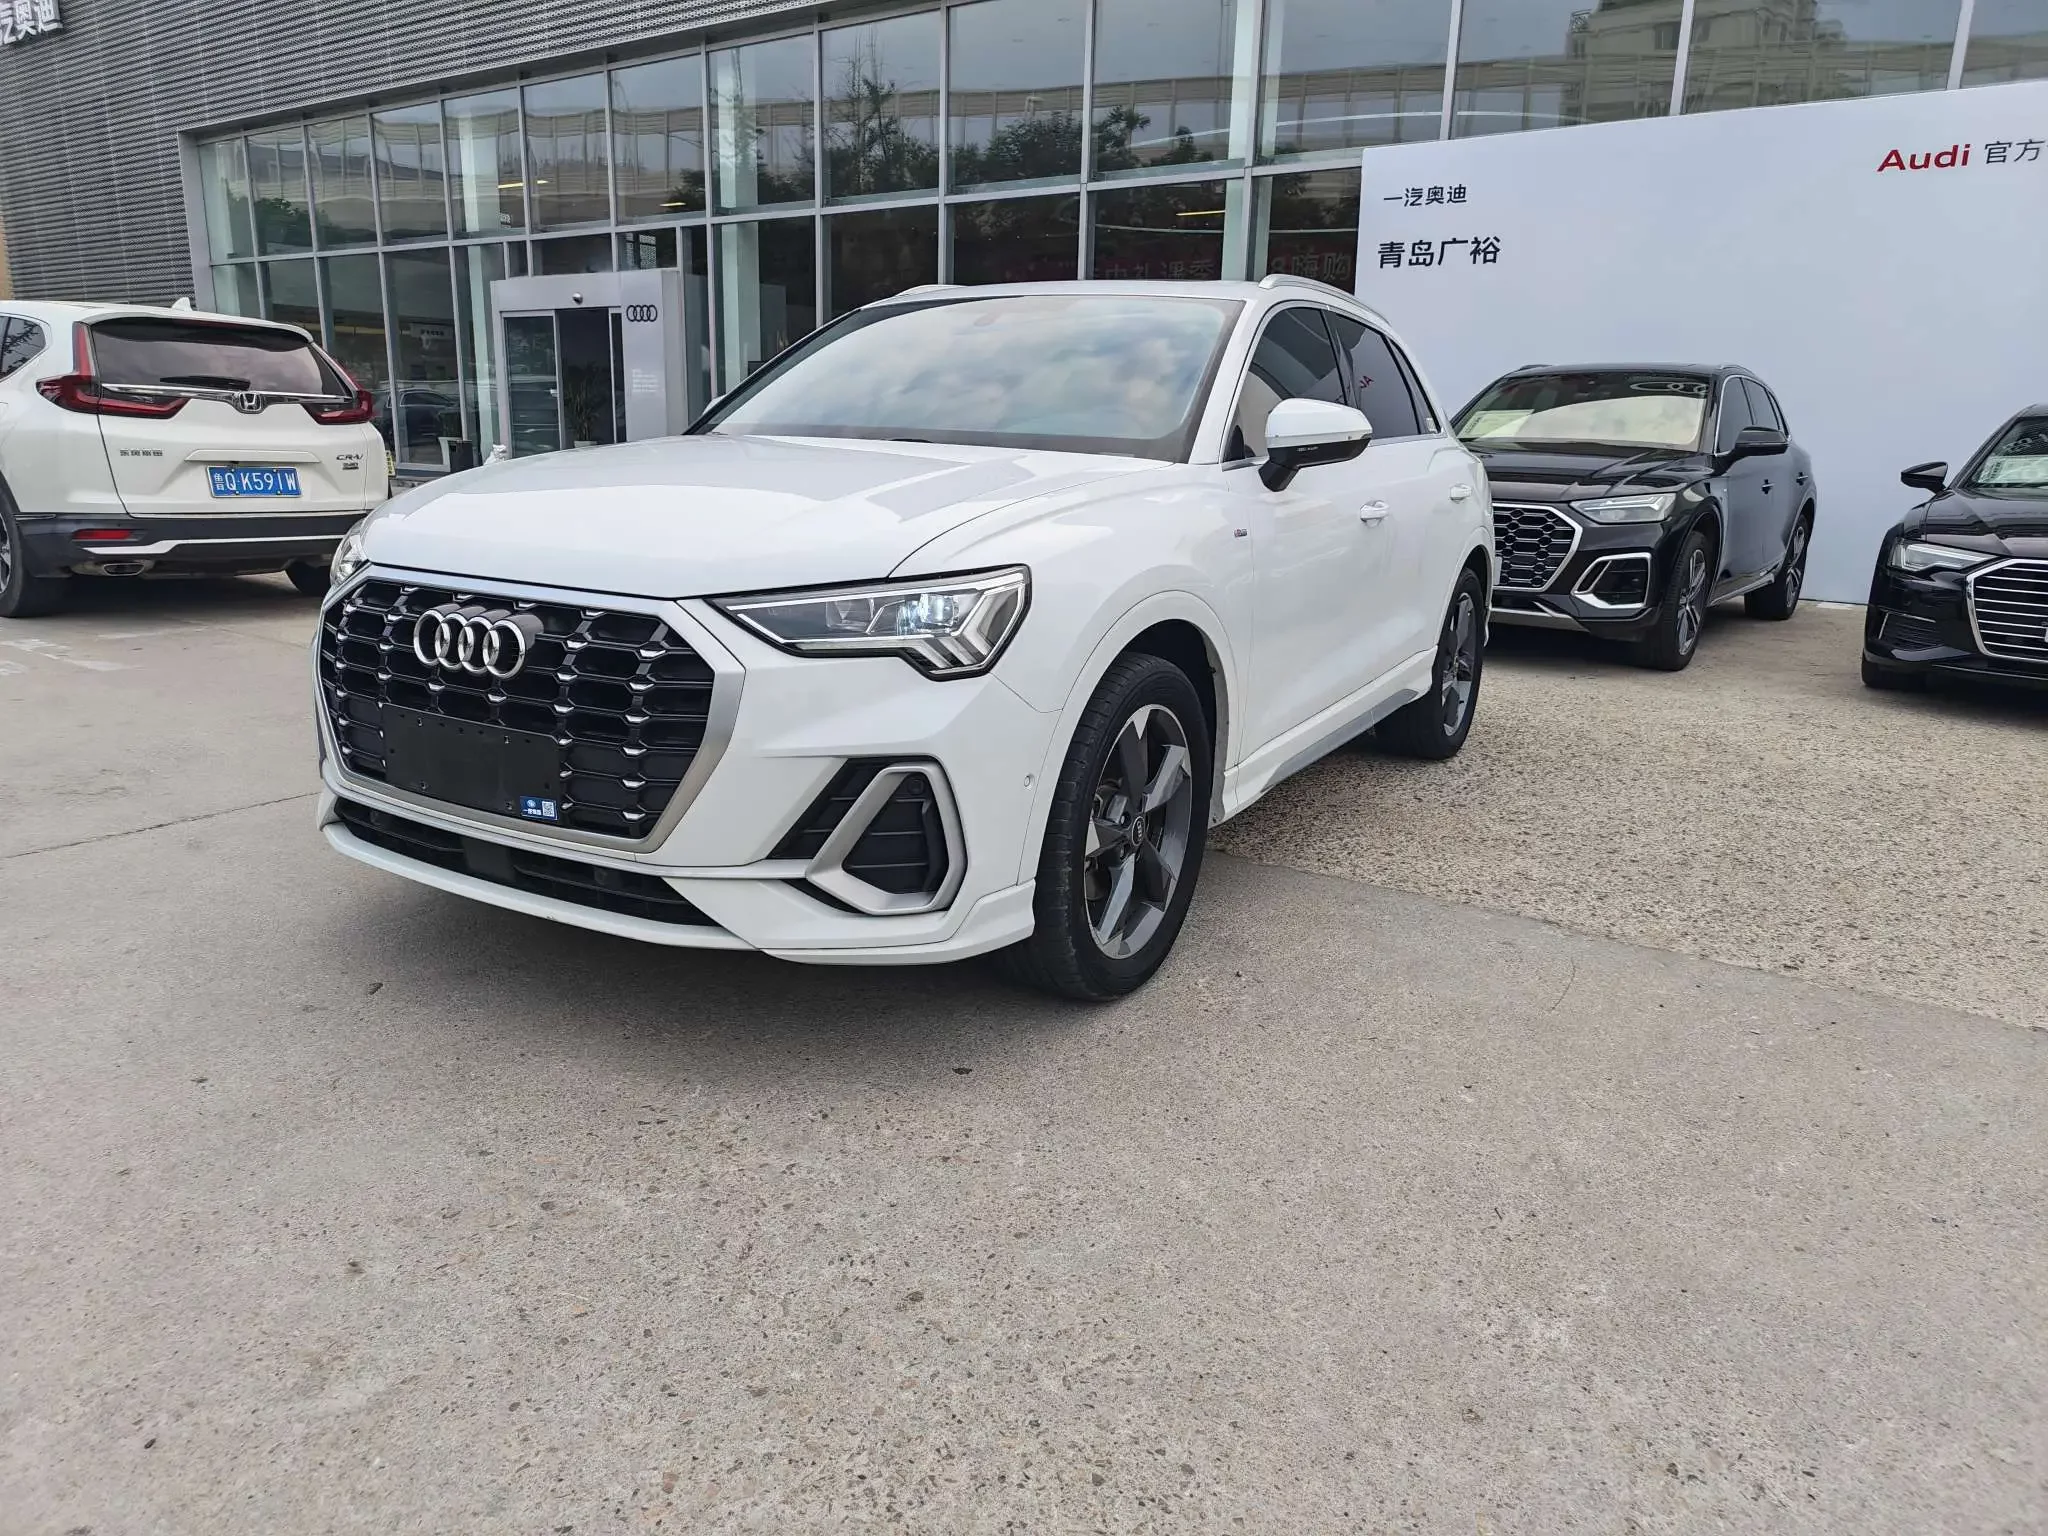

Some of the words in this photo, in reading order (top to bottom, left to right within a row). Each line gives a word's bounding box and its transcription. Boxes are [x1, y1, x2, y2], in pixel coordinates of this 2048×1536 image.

[1877, 143, 1971, 172] Audi
[1984, 138, 2048, 165] 官方
[1383, 183, 1467, 207] 一汽奥迪
[1378, 236, 1501, 269] 青岛广裕
